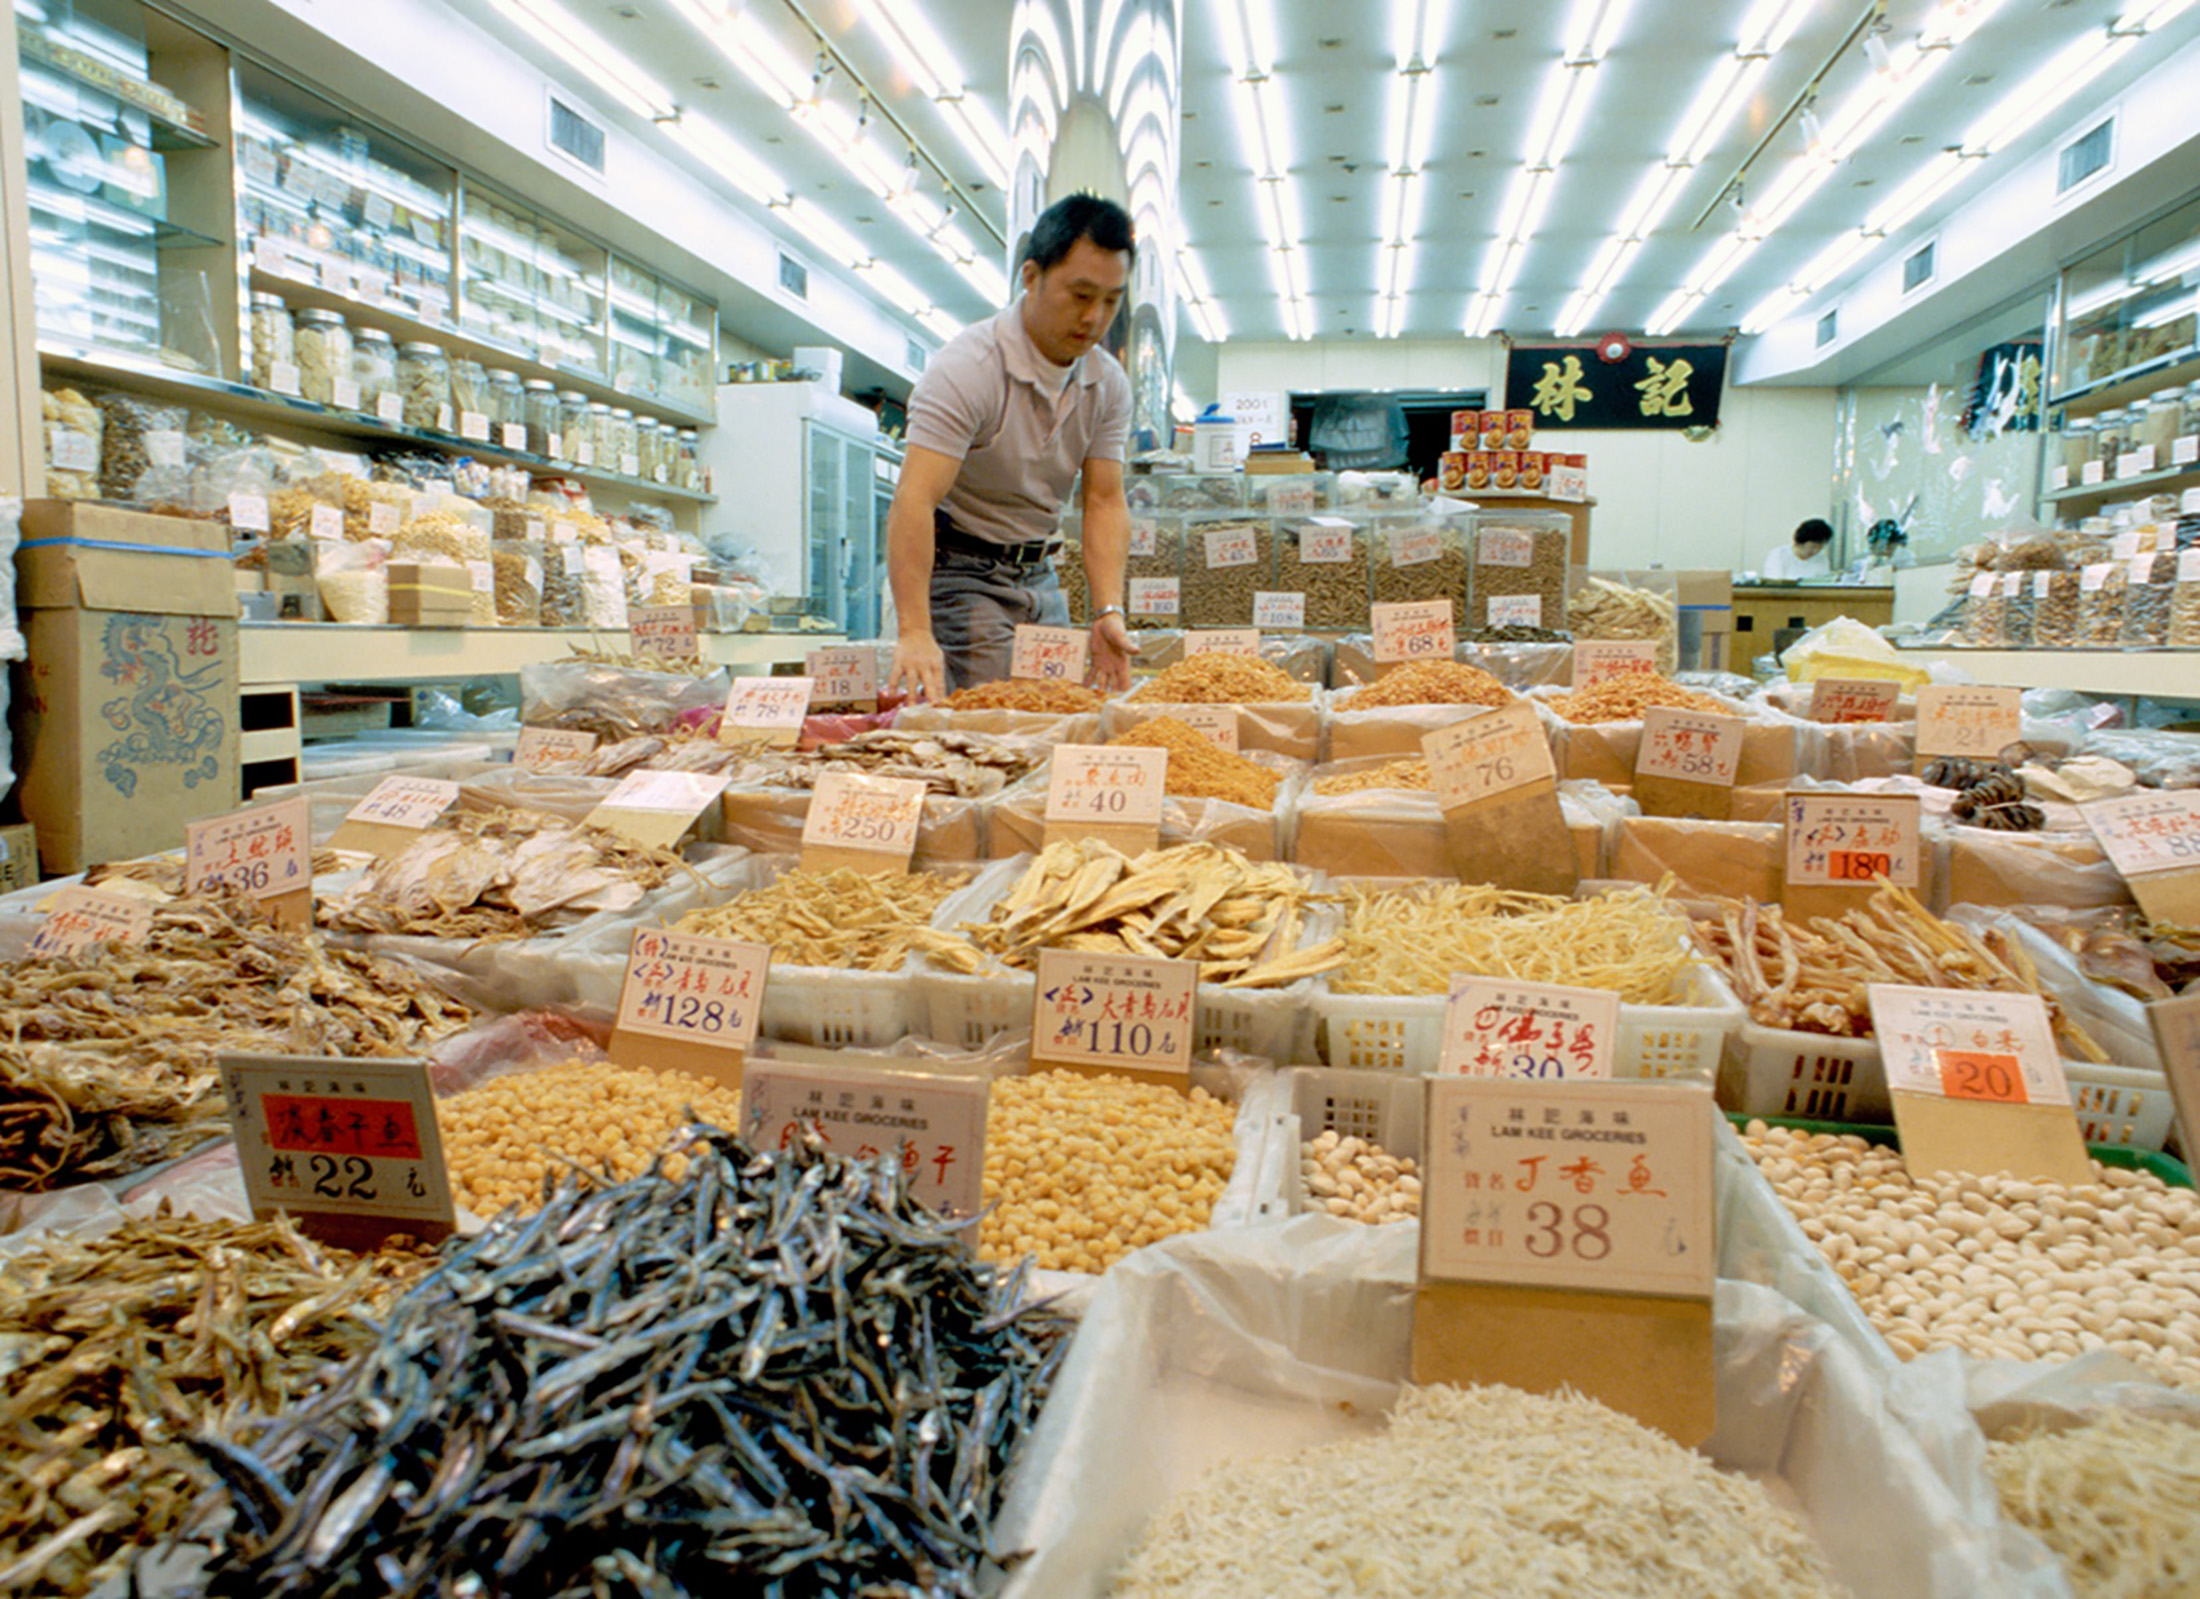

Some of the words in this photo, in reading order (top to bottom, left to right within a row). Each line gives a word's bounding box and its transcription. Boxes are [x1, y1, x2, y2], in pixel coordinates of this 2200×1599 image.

[1529, 354, 1694, 423] 林記
[654, 636, 676, 652] 72
[1408, 634, 1434, 654] 68
[1042, 660, 1066, 678] 80
[830, 680, 851, 695] 18
[756, 703, 780, 718] 78
[1955, 726, 1987, 748] 24
[1475, 756, 1514, 787] 76
[1682, 753, 1714, 775] 58
[382, 803, 412, 819] 48
[1089, 790, 1127, 813] 40
[841, 816, 896, 842] 250
[232, 860, 270, 891] 36
[1841, 852, 1891, 880] 180
[662, 994, 725, 1033] 128
[1087, 1020, 1152, 1057] 110
[1511, 1053, 1564, 1079] 30
[1956, 1060, 2012, 1098] 20
[792, 1106, 820, 1121] LAM
[823, 1109, 849, 1124] KEE
[853, 1111, 929, 1131] GROCERIES
[1491, 1124, 1523, 1139] LAM
[1527, 1126, 1556, 1141] KEE
[1560, 1127, 1648, 1146] GROCERIES
[309, 1154, 378, 1200] 22
[1524, 1200, 1613, 1261] 38
